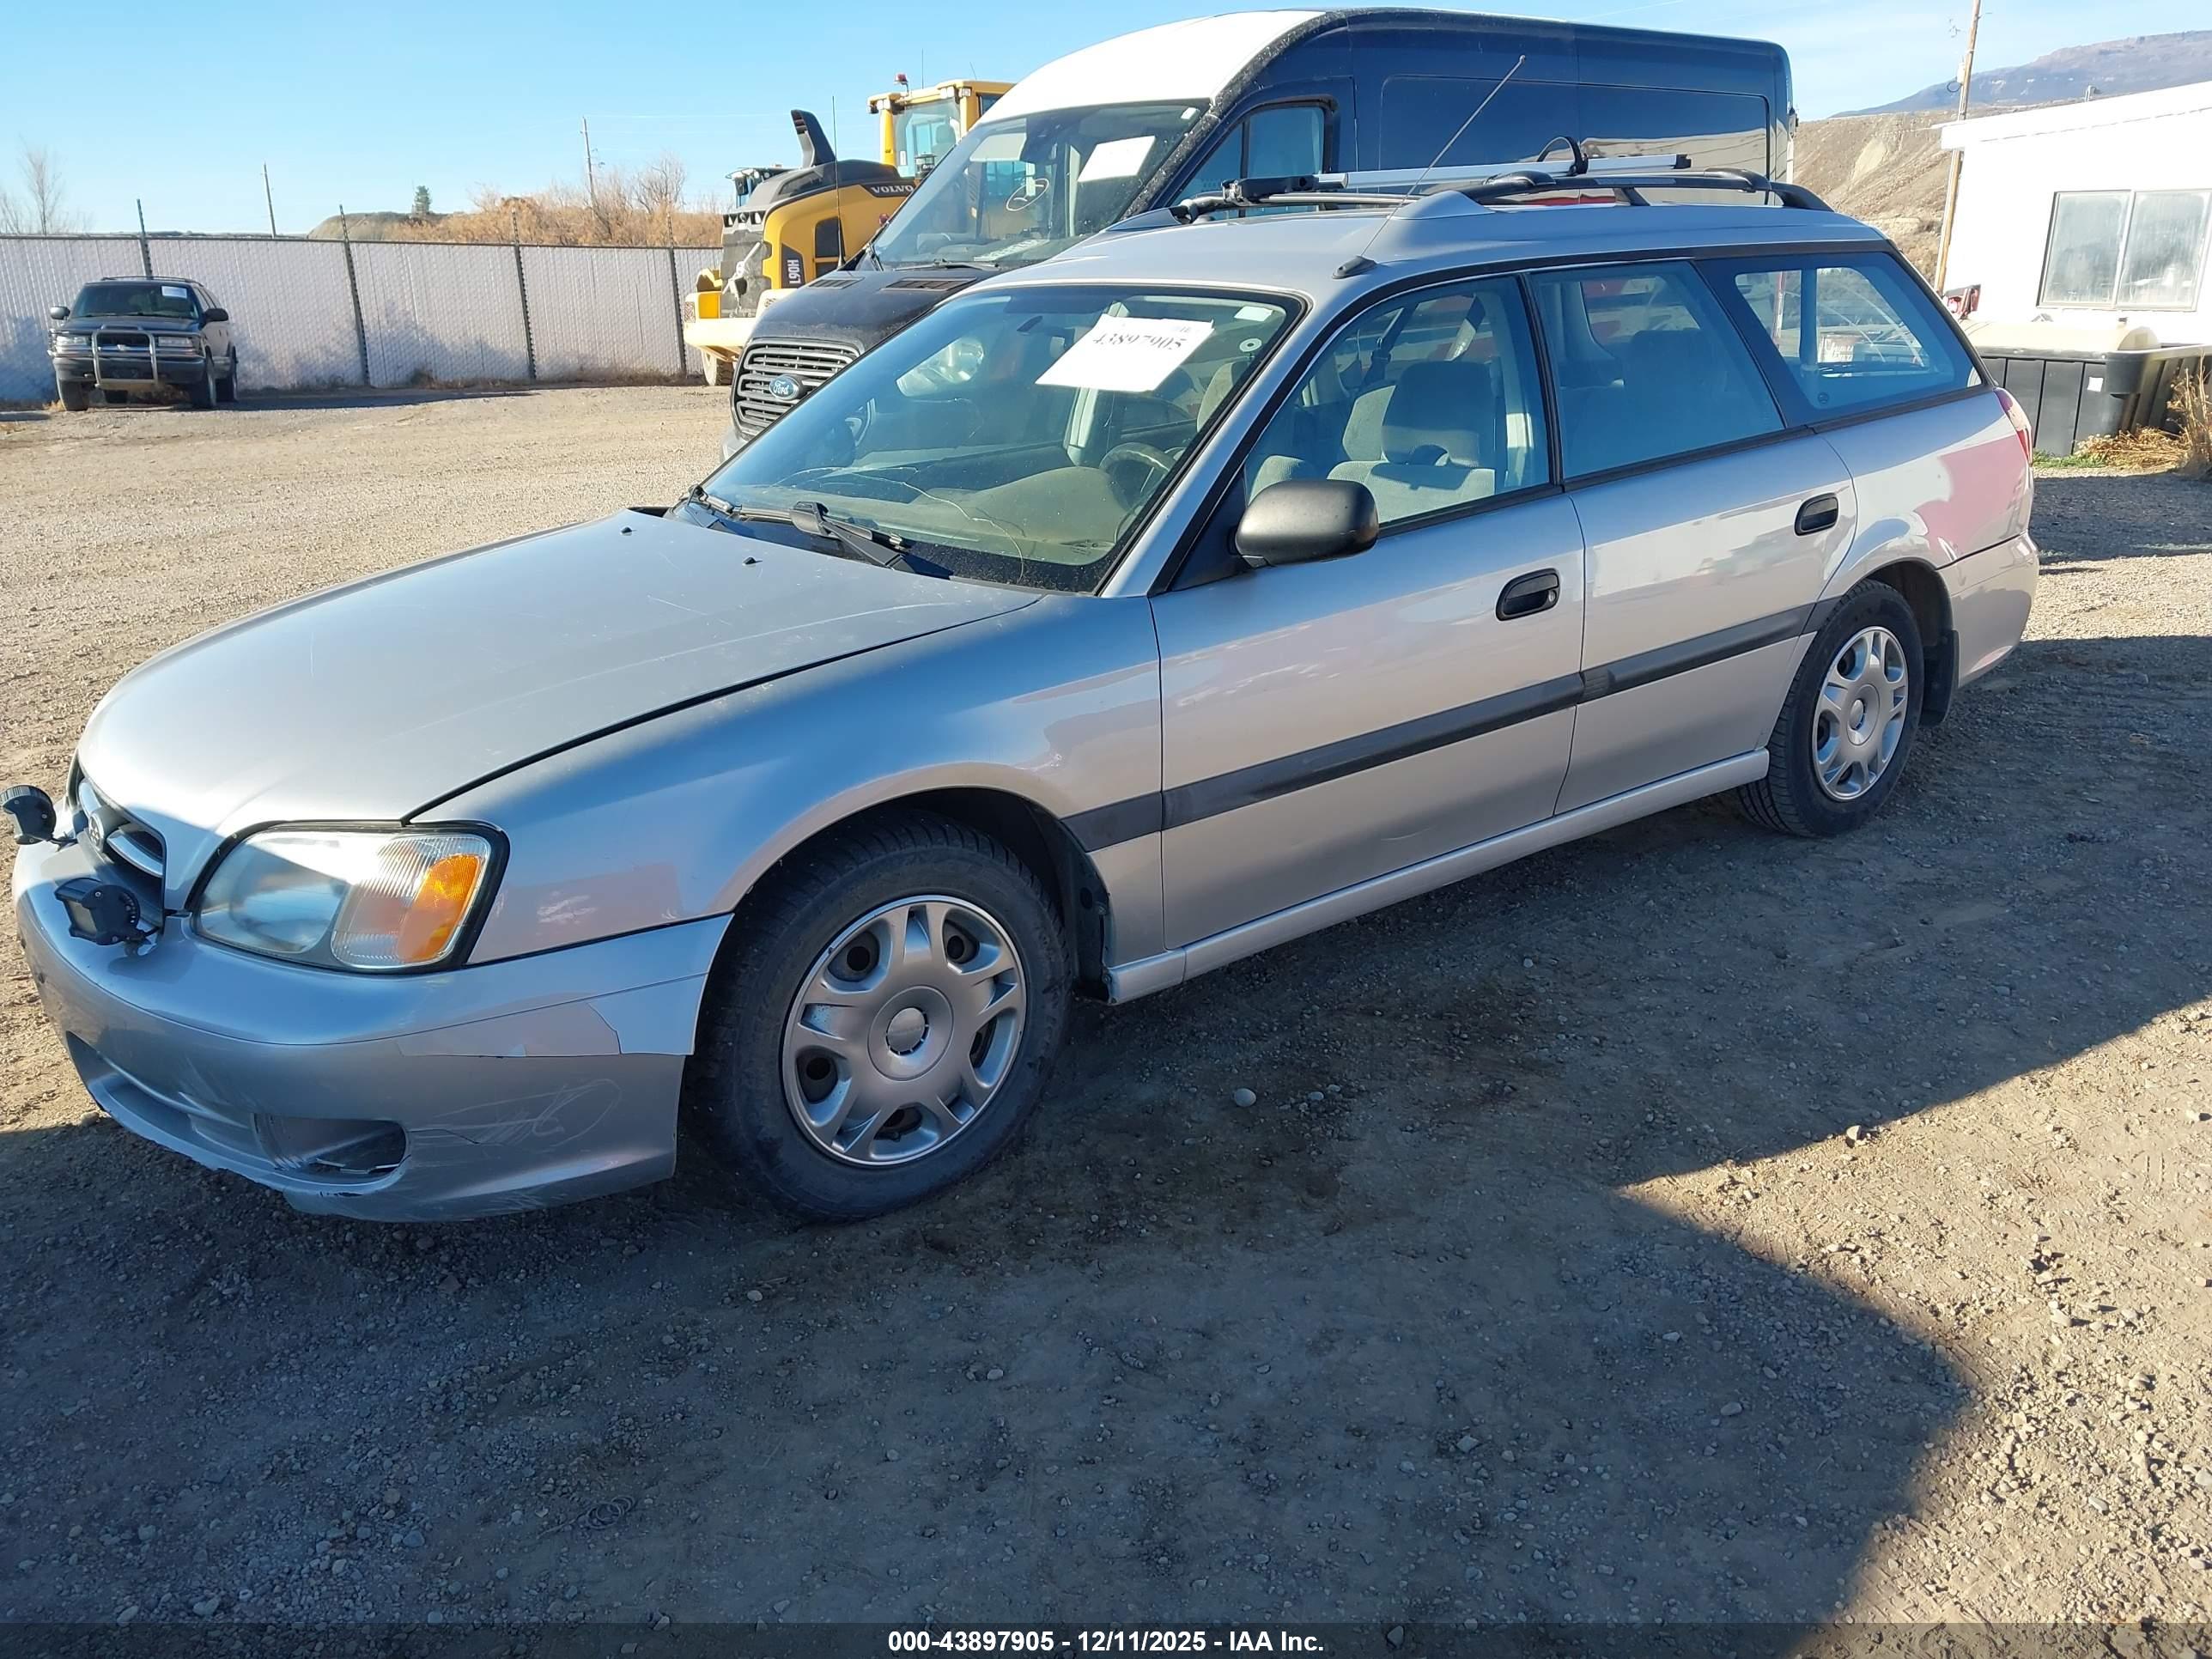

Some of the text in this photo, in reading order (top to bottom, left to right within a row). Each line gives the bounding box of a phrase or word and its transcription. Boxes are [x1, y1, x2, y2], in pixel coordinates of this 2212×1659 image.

[871, 185, 915, 194] VOLVO
[787, 259, 802, 284] L90H
[1092, 332, 1188, 350] 43897905
[773, 380, 790, 395] Ford
